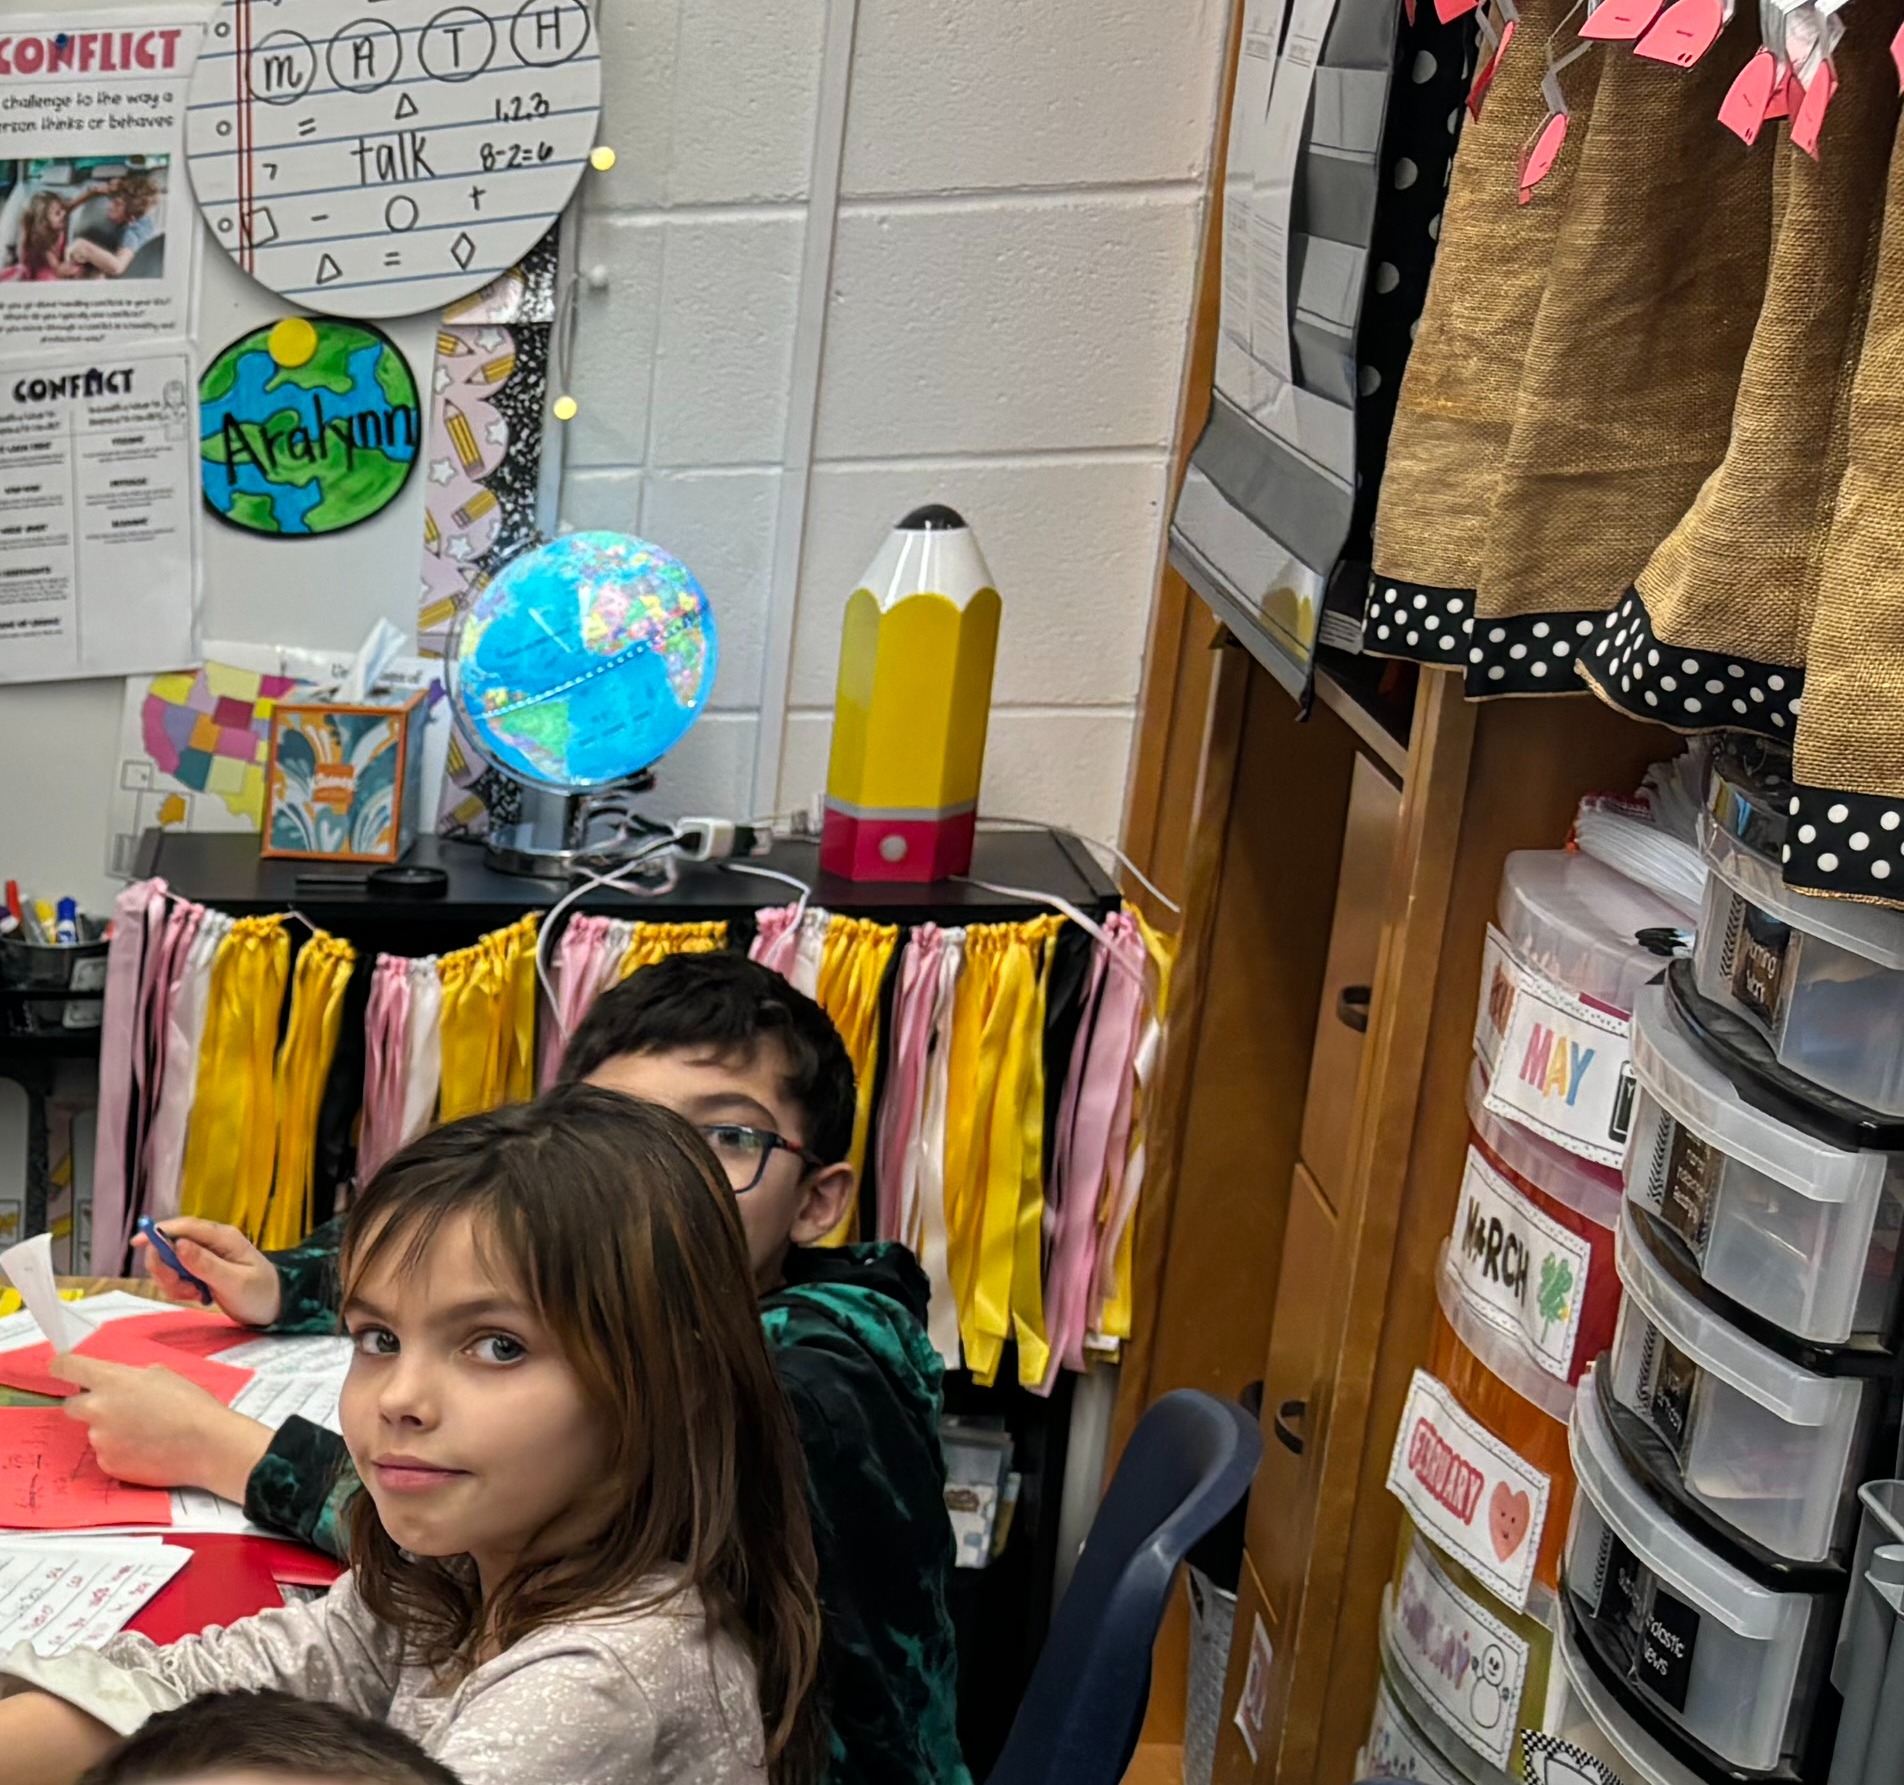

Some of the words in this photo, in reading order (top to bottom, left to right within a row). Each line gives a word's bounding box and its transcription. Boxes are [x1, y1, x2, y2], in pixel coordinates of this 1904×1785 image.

[2, 94, 72, 111] challenge
[77, 94, 92, 106] to
[97, 92, 122, 105] the
[126, 93, 159, 109] way
[163, 92, 173, 102] a
[42, 117, 84, 131] thinks
[88, 119, 103, 130] or
[109, 115, 174, 129] behaves
[351, 131, 436, 186] talk
[221, 394, 417, 486] Aralynn
[1519, 1023, 1595, 1107] MAY
[1462, 1196, 1529, 1307] MARCH
